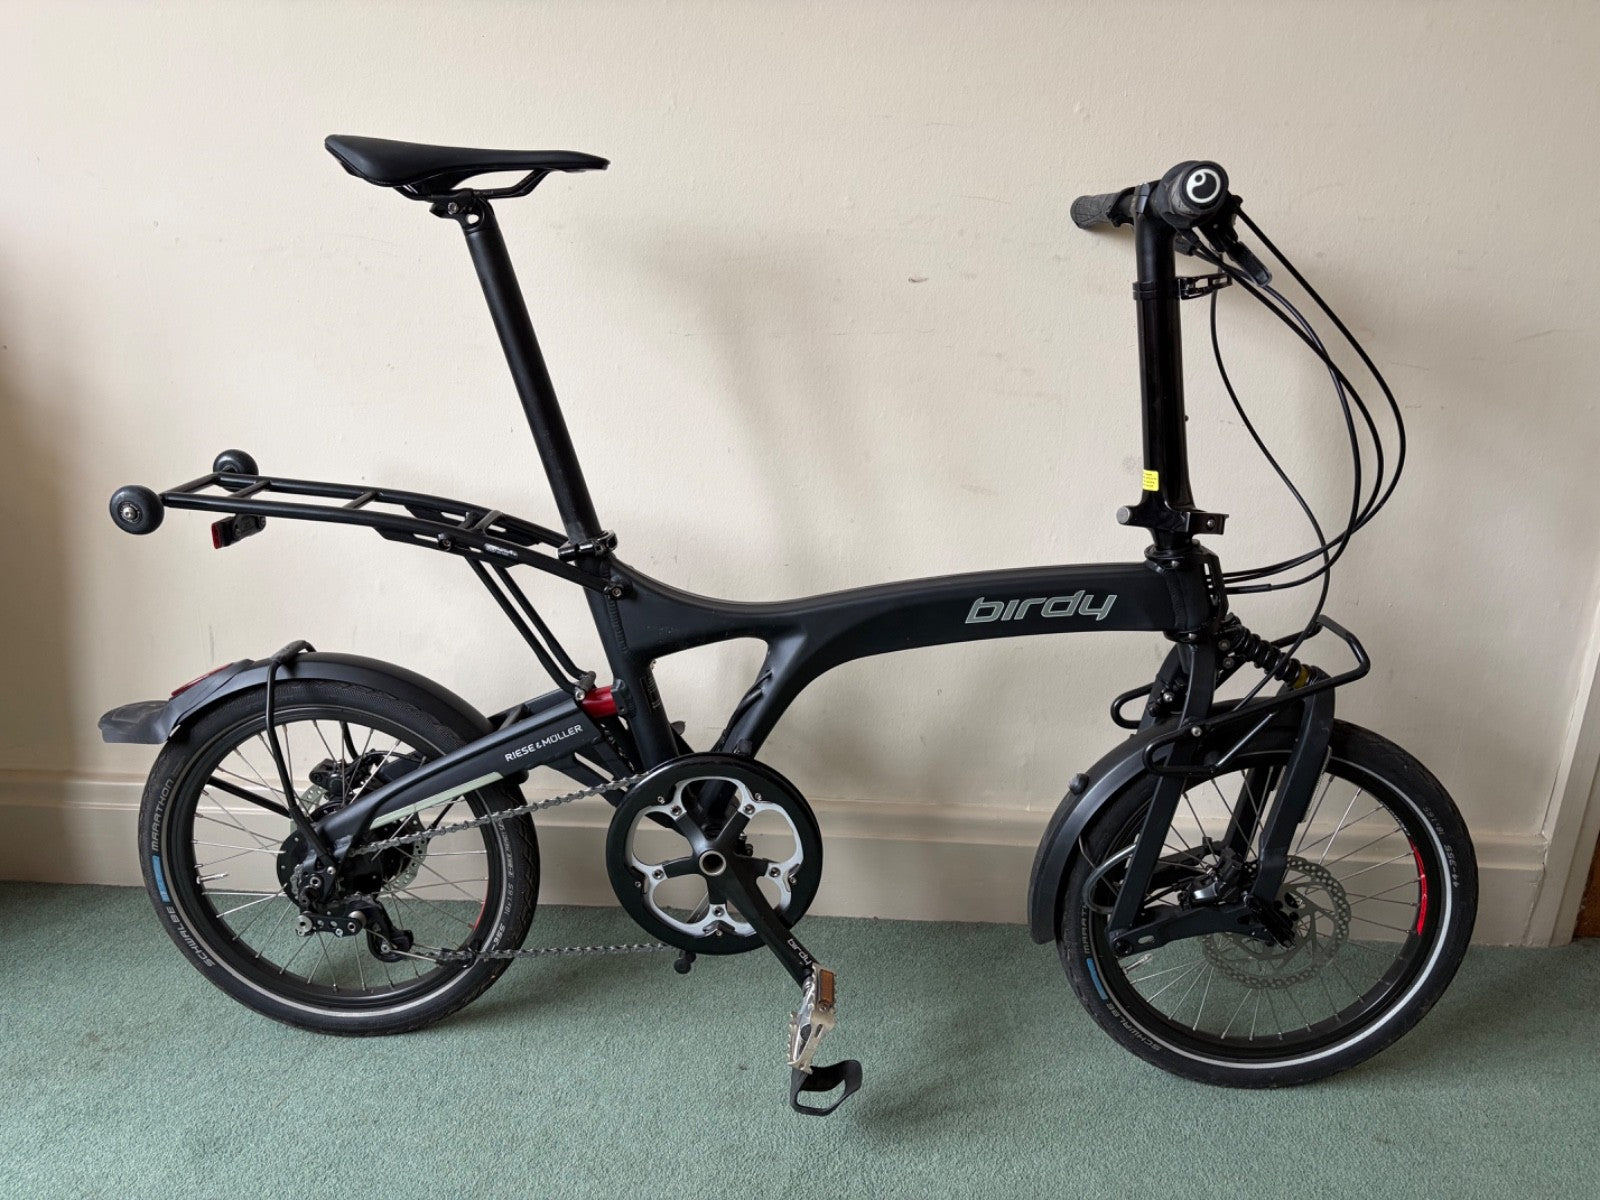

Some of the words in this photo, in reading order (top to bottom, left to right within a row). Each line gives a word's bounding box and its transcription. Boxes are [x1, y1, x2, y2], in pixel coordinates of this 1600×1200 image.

[965, 590, 1117, 624] birdy
[151, 779, 174, 852] MARATHON
[166, 906, 216, 967] SCHWALBE
[787, 938, 812, 966] birdy
[1106, 1002, 1162, 1051] SCHWALBE
